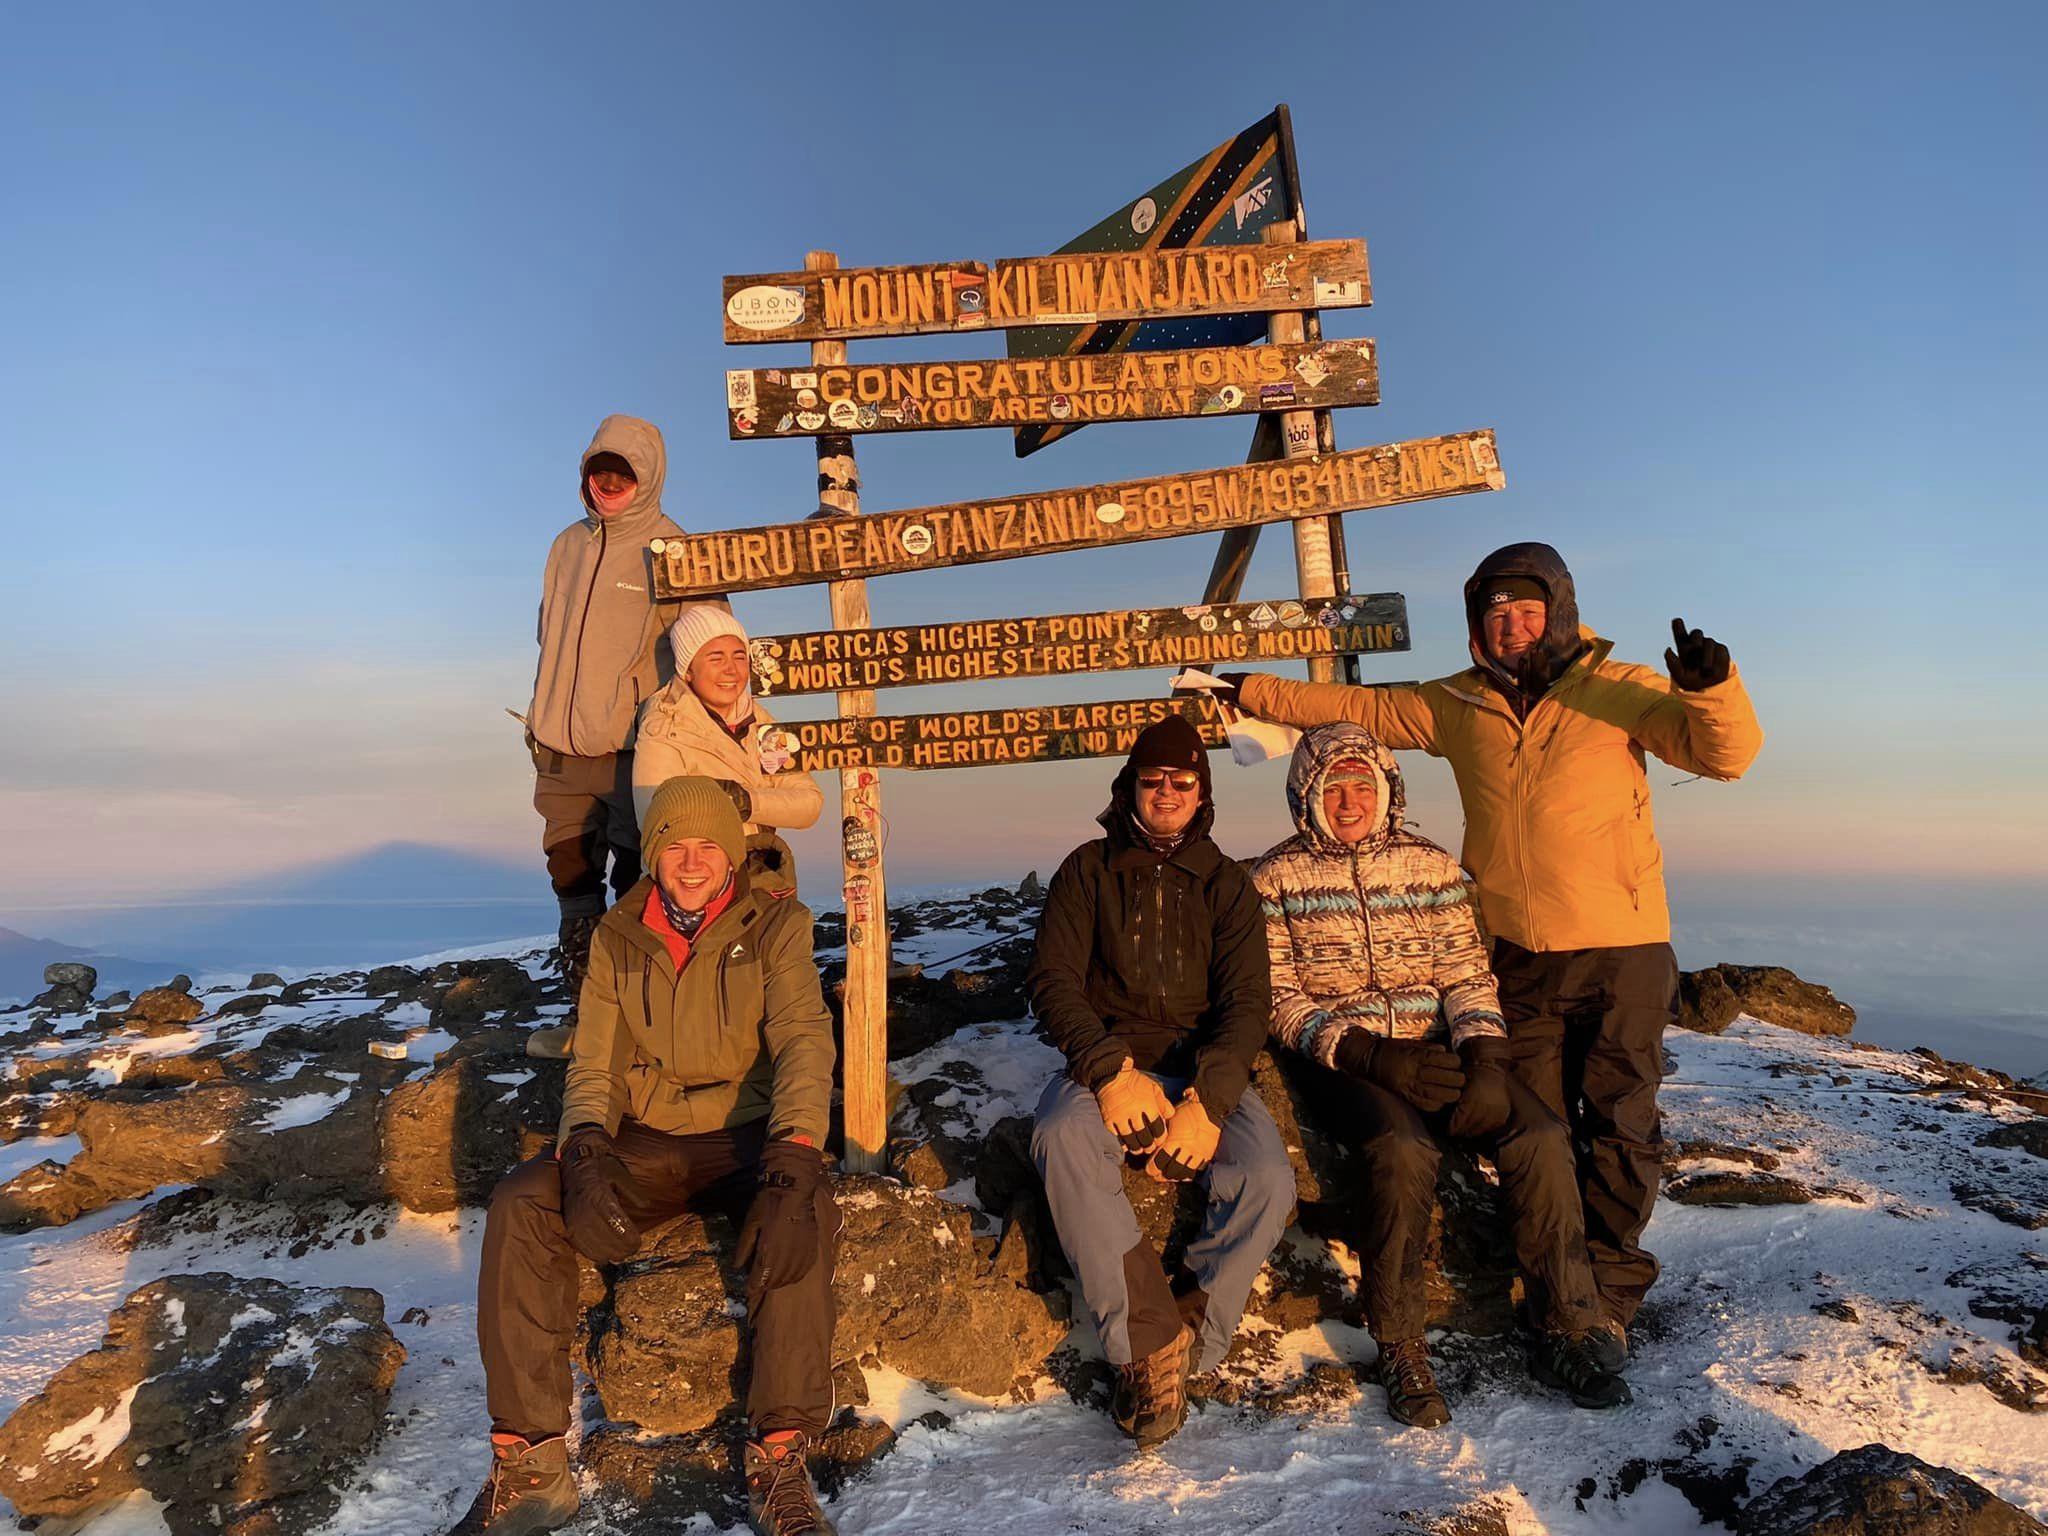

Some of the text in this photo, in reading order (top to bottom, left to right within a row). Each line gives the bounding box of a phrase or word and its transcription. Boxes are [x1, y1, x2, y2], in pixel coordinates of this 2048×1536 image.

[732, 297, 797, 310] UBON
[822, 252, 1260, 329] MOUNT KILIMANJARO
[819, 347, 1288, 403] CONGRATULATIONS
[918, 389, 1196, 423] YOU ARE NOW AT
[1287, 430, 1310, 443] 100
[667, 528, 795, 588] UHURU
[1399, 438, 1487, 495] AMSL
[788, 611, 1130, 661] AFRICA'S HIGHEST POINT
[788, 657, 907, 690] WORLD'S
[916, 648, 1042, 680] HIGHEST
[1258, 624, 1394, 656] MOUNTAIN
[800, 721, 858, 747] ONE
[870, 719, 906, 742] OF
[919, 711, 1041, 738] WORLD'S
[1053, 700, 1184, 730] LARGEST
[801, 744, 904, 771] WORLD
[913, 735, 1049, 765] HERITAGE
[1059, 730, 1108, 756] AND
